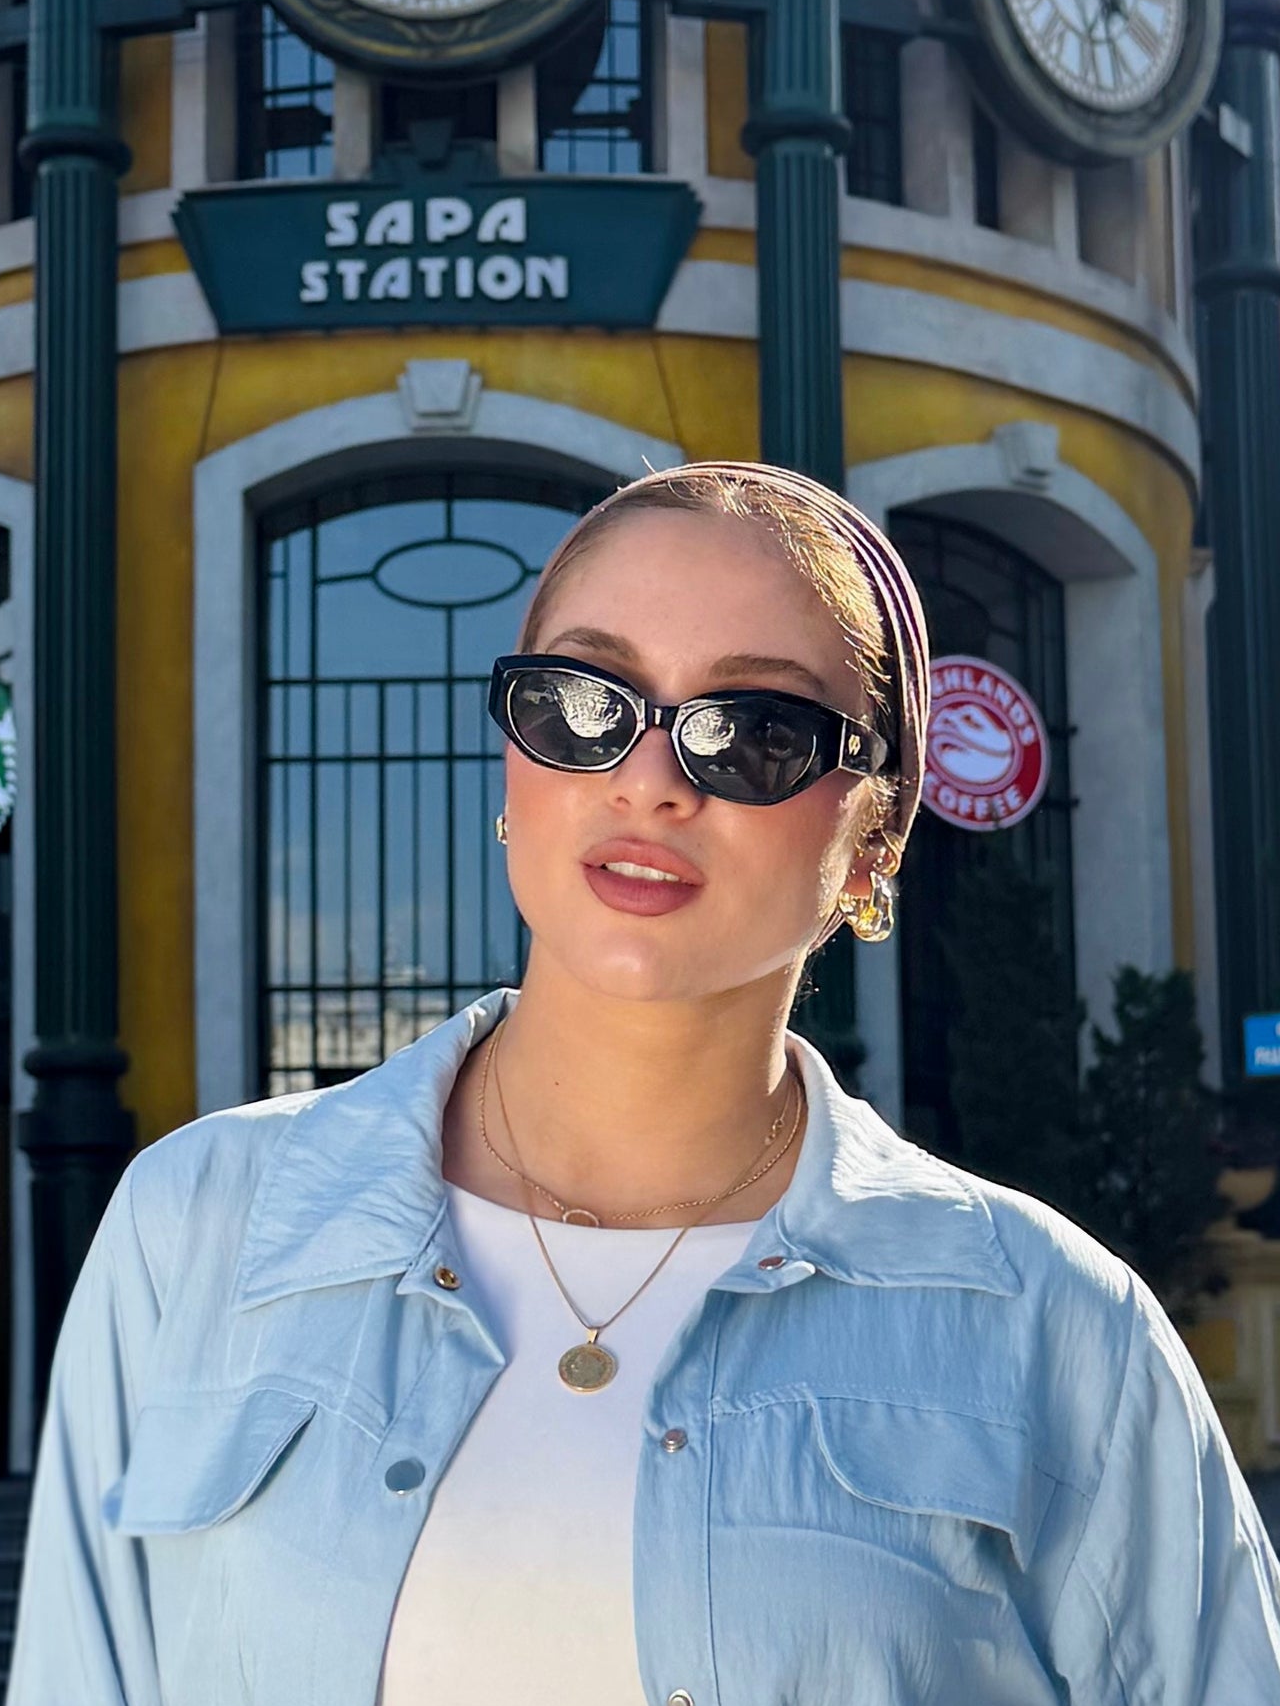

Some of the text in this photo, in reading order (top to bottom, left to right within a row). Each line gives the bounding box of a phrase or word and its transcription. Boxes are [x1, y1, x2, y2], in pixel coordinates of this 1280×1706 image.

[325, 197, 527, 248] SAPA
[300, 255, 569, 304] STATION
[923, 771, 1023, 821] COFFEE
